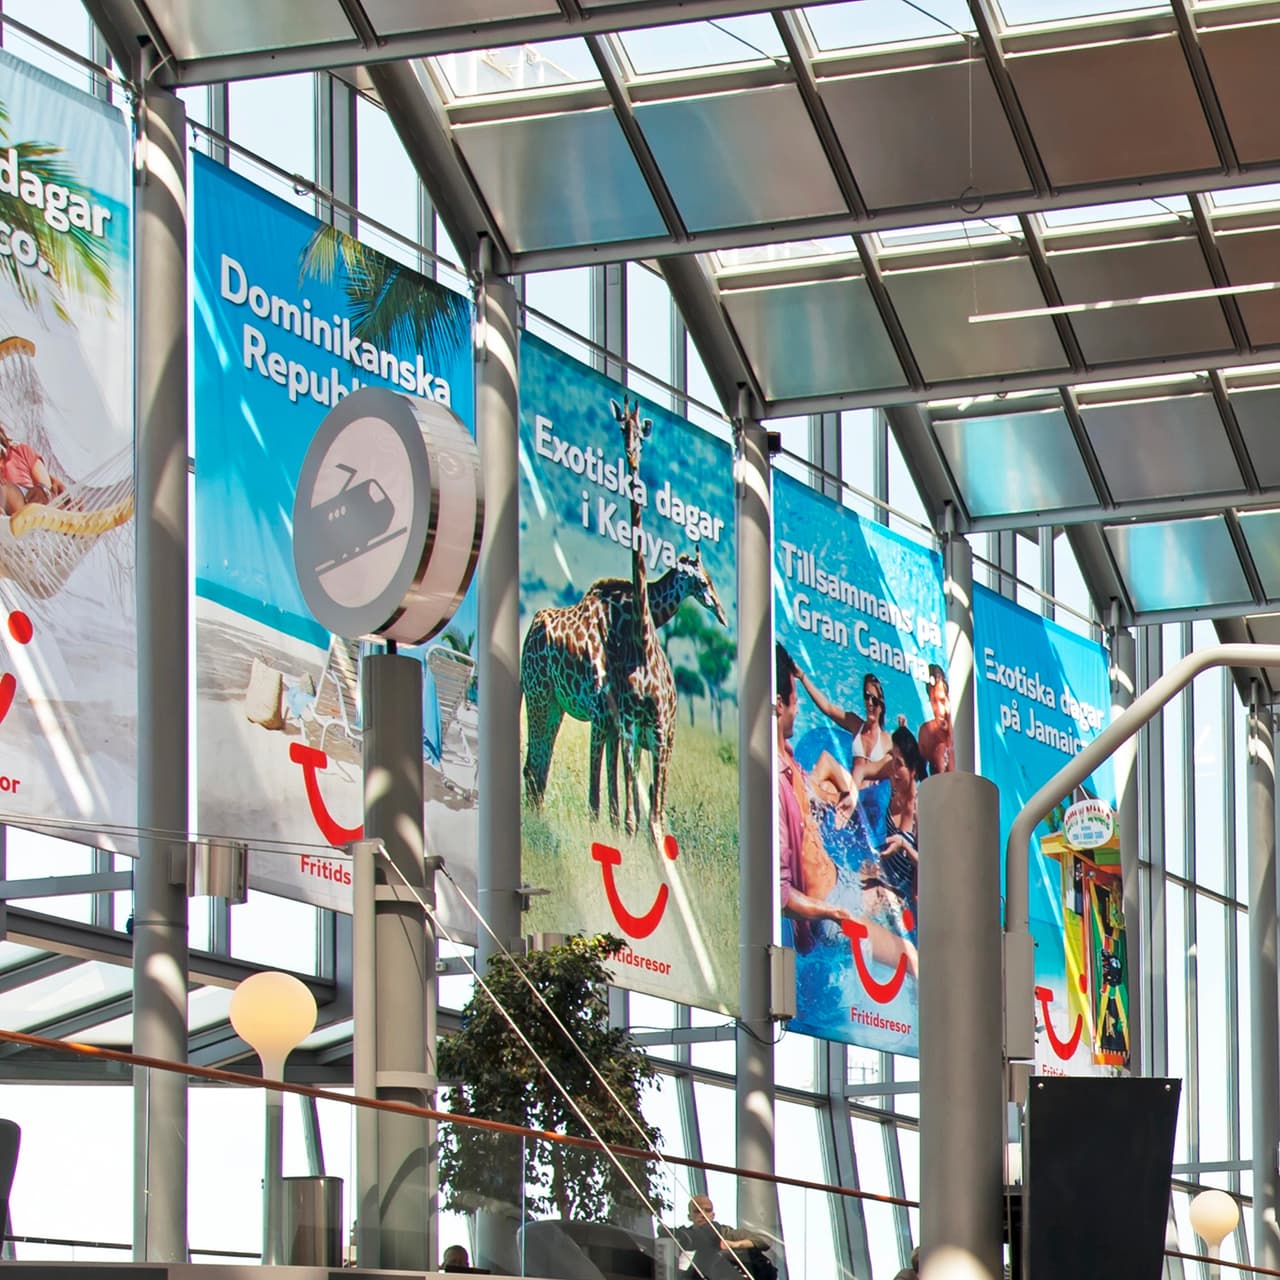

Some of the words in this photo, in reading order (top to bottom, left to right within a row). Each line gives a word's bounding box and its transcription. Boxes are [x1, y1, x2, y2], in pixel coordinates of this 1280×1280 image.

[0, 148, 112, 237] dagar
[221, 254, 451, 406] Dominikanska
[243, 323, 367, 408] Repub
[535, 414, 648, 507] Exotiska
[655, 480, 725, 543] dagar
[581, 490, 590, 529] i
[780, 539, 914, 634] Tillsammans
[916, 611, 943, 649] på
[793, 593, 849, 648] Gran
[984, 646, 1056, 709] Exotiska
[1060, 685, 1105, 733] dagar
[1000, 699, 1022, 733] på
[301, 854, 352, 885] Fritids
[606, 945, 672, 975] itidsresor
[851, 1006, 912, 1035] Fritidsresor
